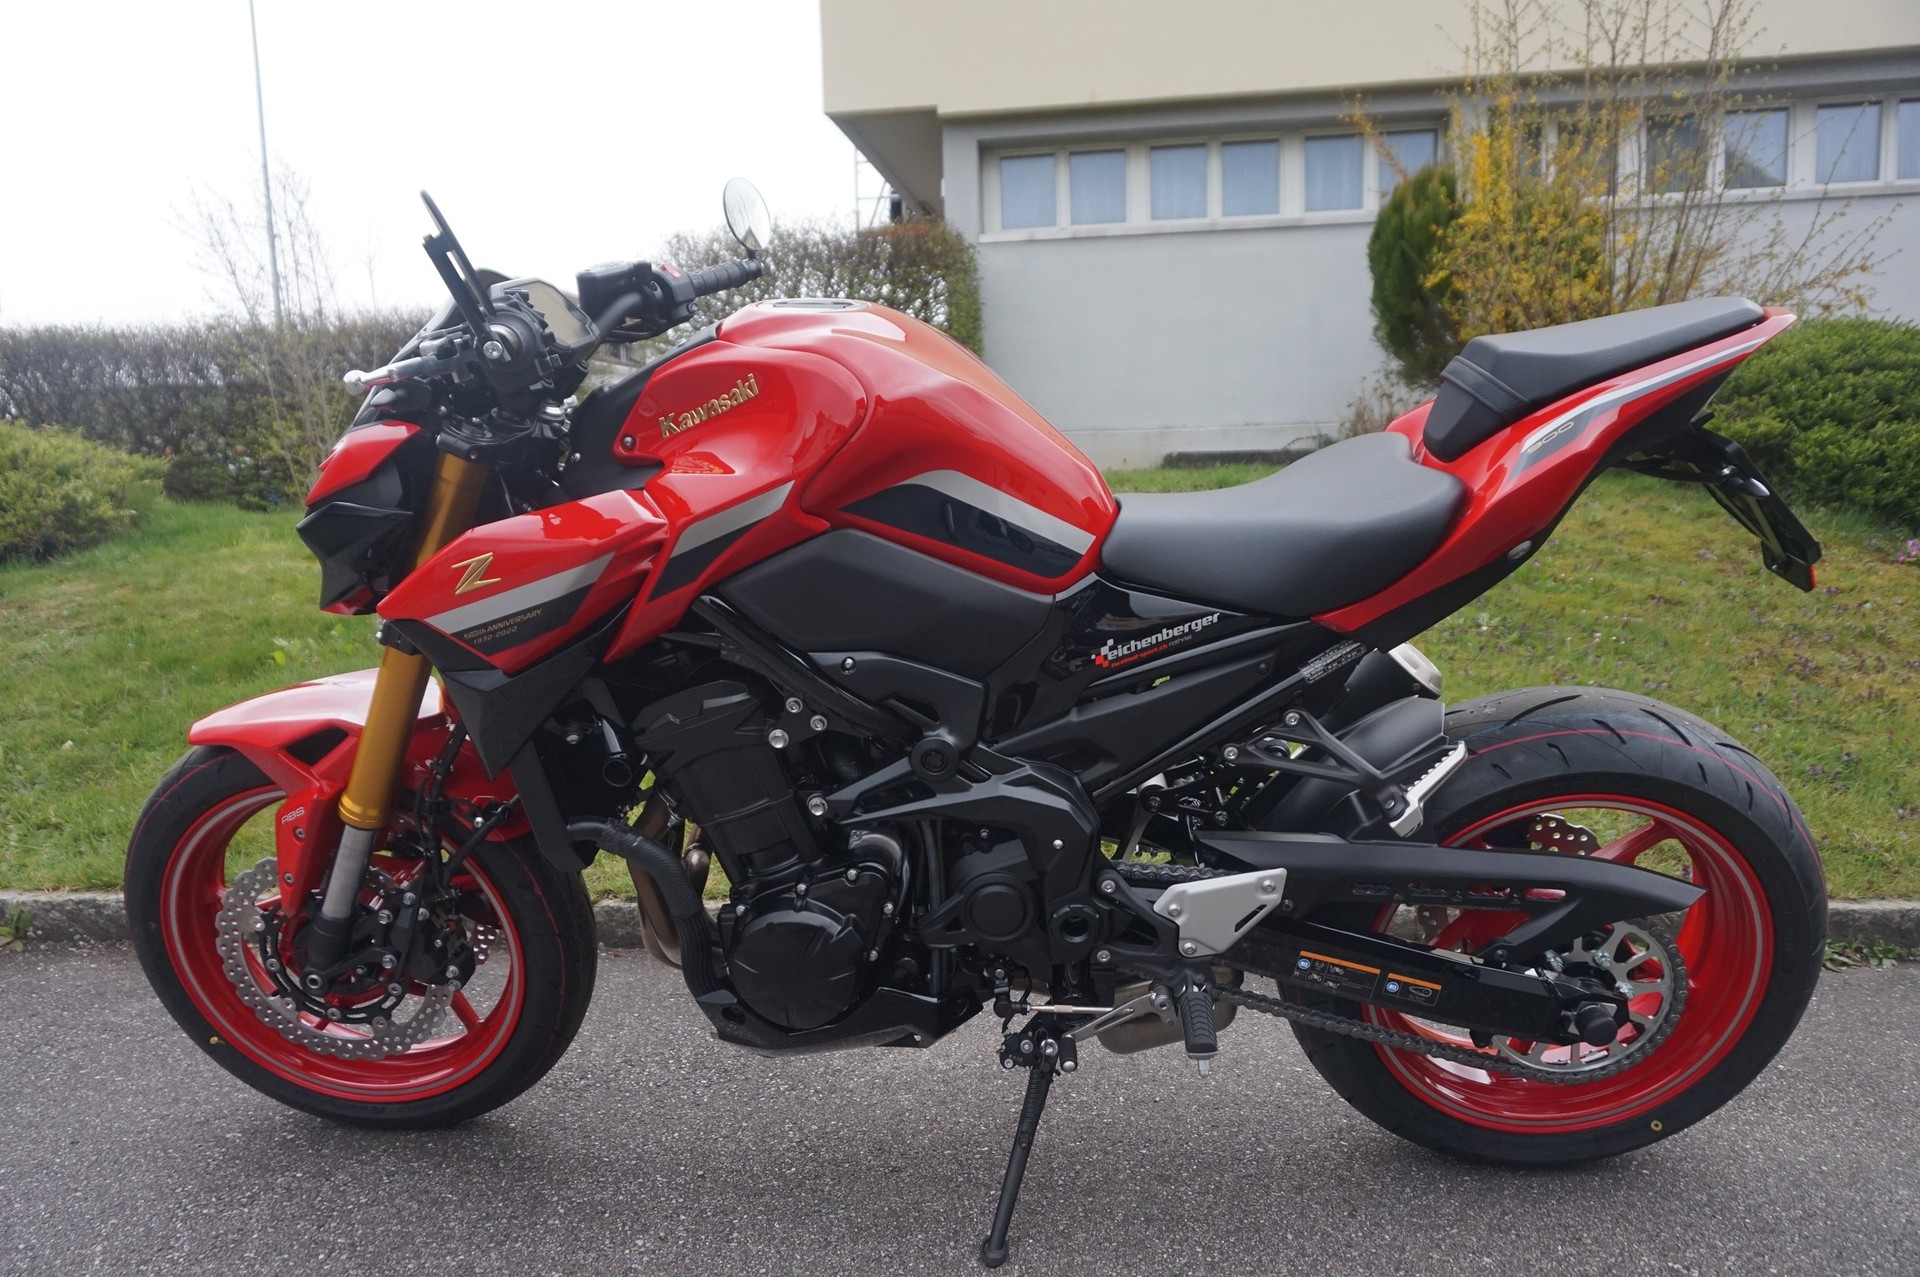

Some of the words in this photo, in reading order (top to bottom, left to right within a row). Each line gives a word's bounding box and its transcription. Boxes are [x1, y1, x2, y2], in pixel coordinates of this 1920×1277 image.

[659, 373, 759, 438] Kawasaki
[1527, 421, 1575, 454] 900
[451, 552, 501, 595] Z
[487, 608, 542, 632] ANNIVERSARY
[1107, 612, 1220, 660] eichenberger
[281, 806, 305, 825] ABS
